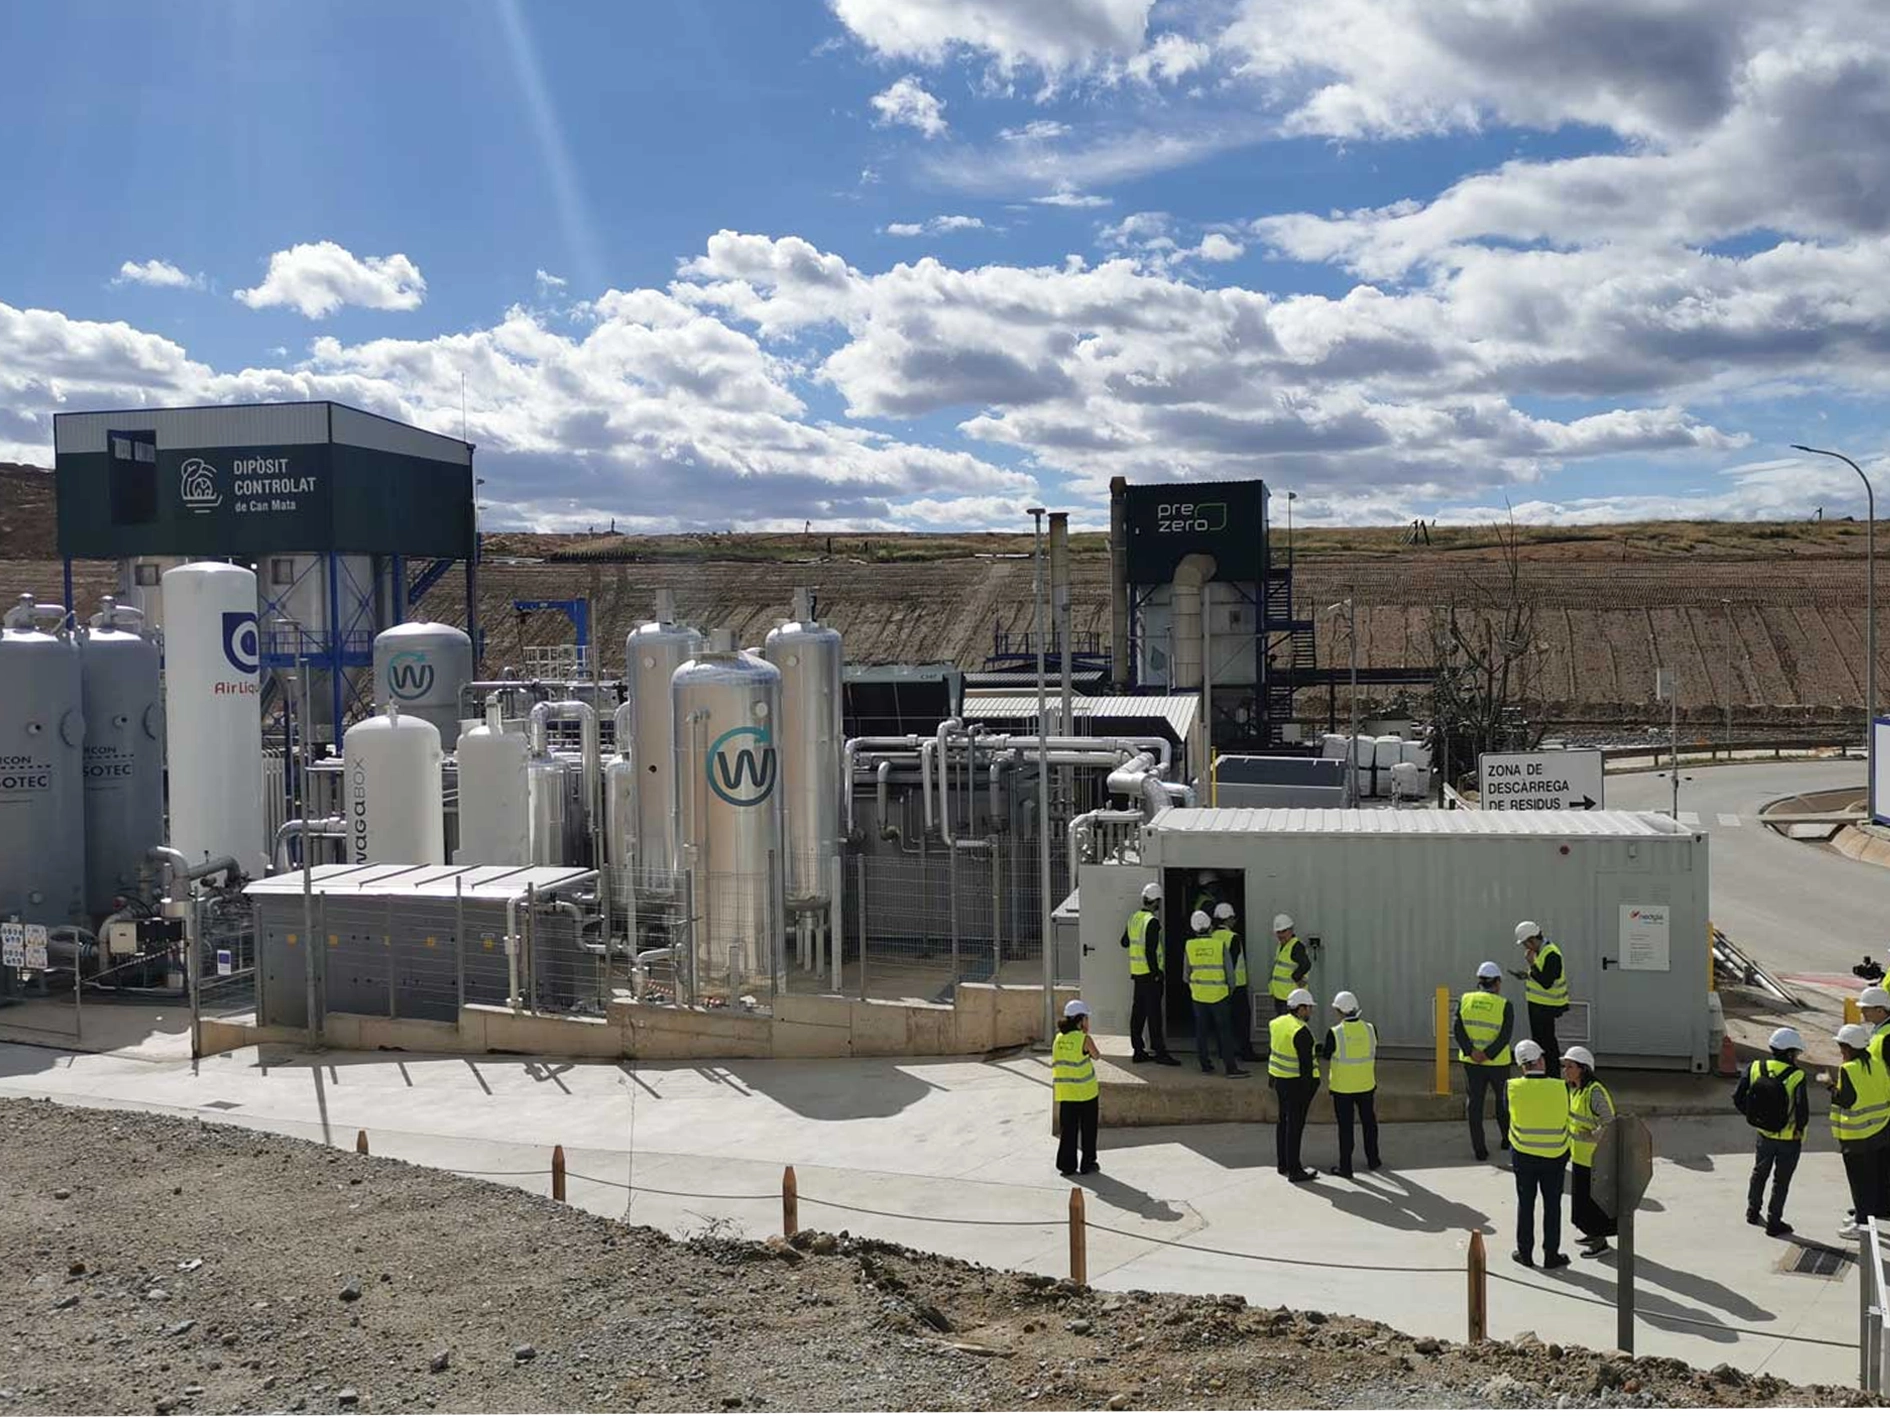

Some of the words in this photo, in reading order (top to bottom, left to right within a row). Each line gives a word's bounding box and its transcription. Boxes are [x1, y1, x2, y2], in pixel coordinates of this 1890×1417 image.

[233, 456, 289, 475] DIPÒSIT
[234, 477, 317, 496] CONTROLAT
[235, 500, 247, 512] de
[249, 500, 268, 512] Can
[271, 499, 296, 511] Mata
[1157, 503, 1194, 519] pre
[1158, 519, 1208, 532] zero
[214, 681, 236, 694] Air
[1488, 764, 1521, 777] ZONA
[1526, 763, 1543, 776] DE
[1488, 779, 1570, 795] DESCÀRREGA
[1489, 800, 1505, 811] DE
[1510, 798, 1561, 811] RESIDUS
